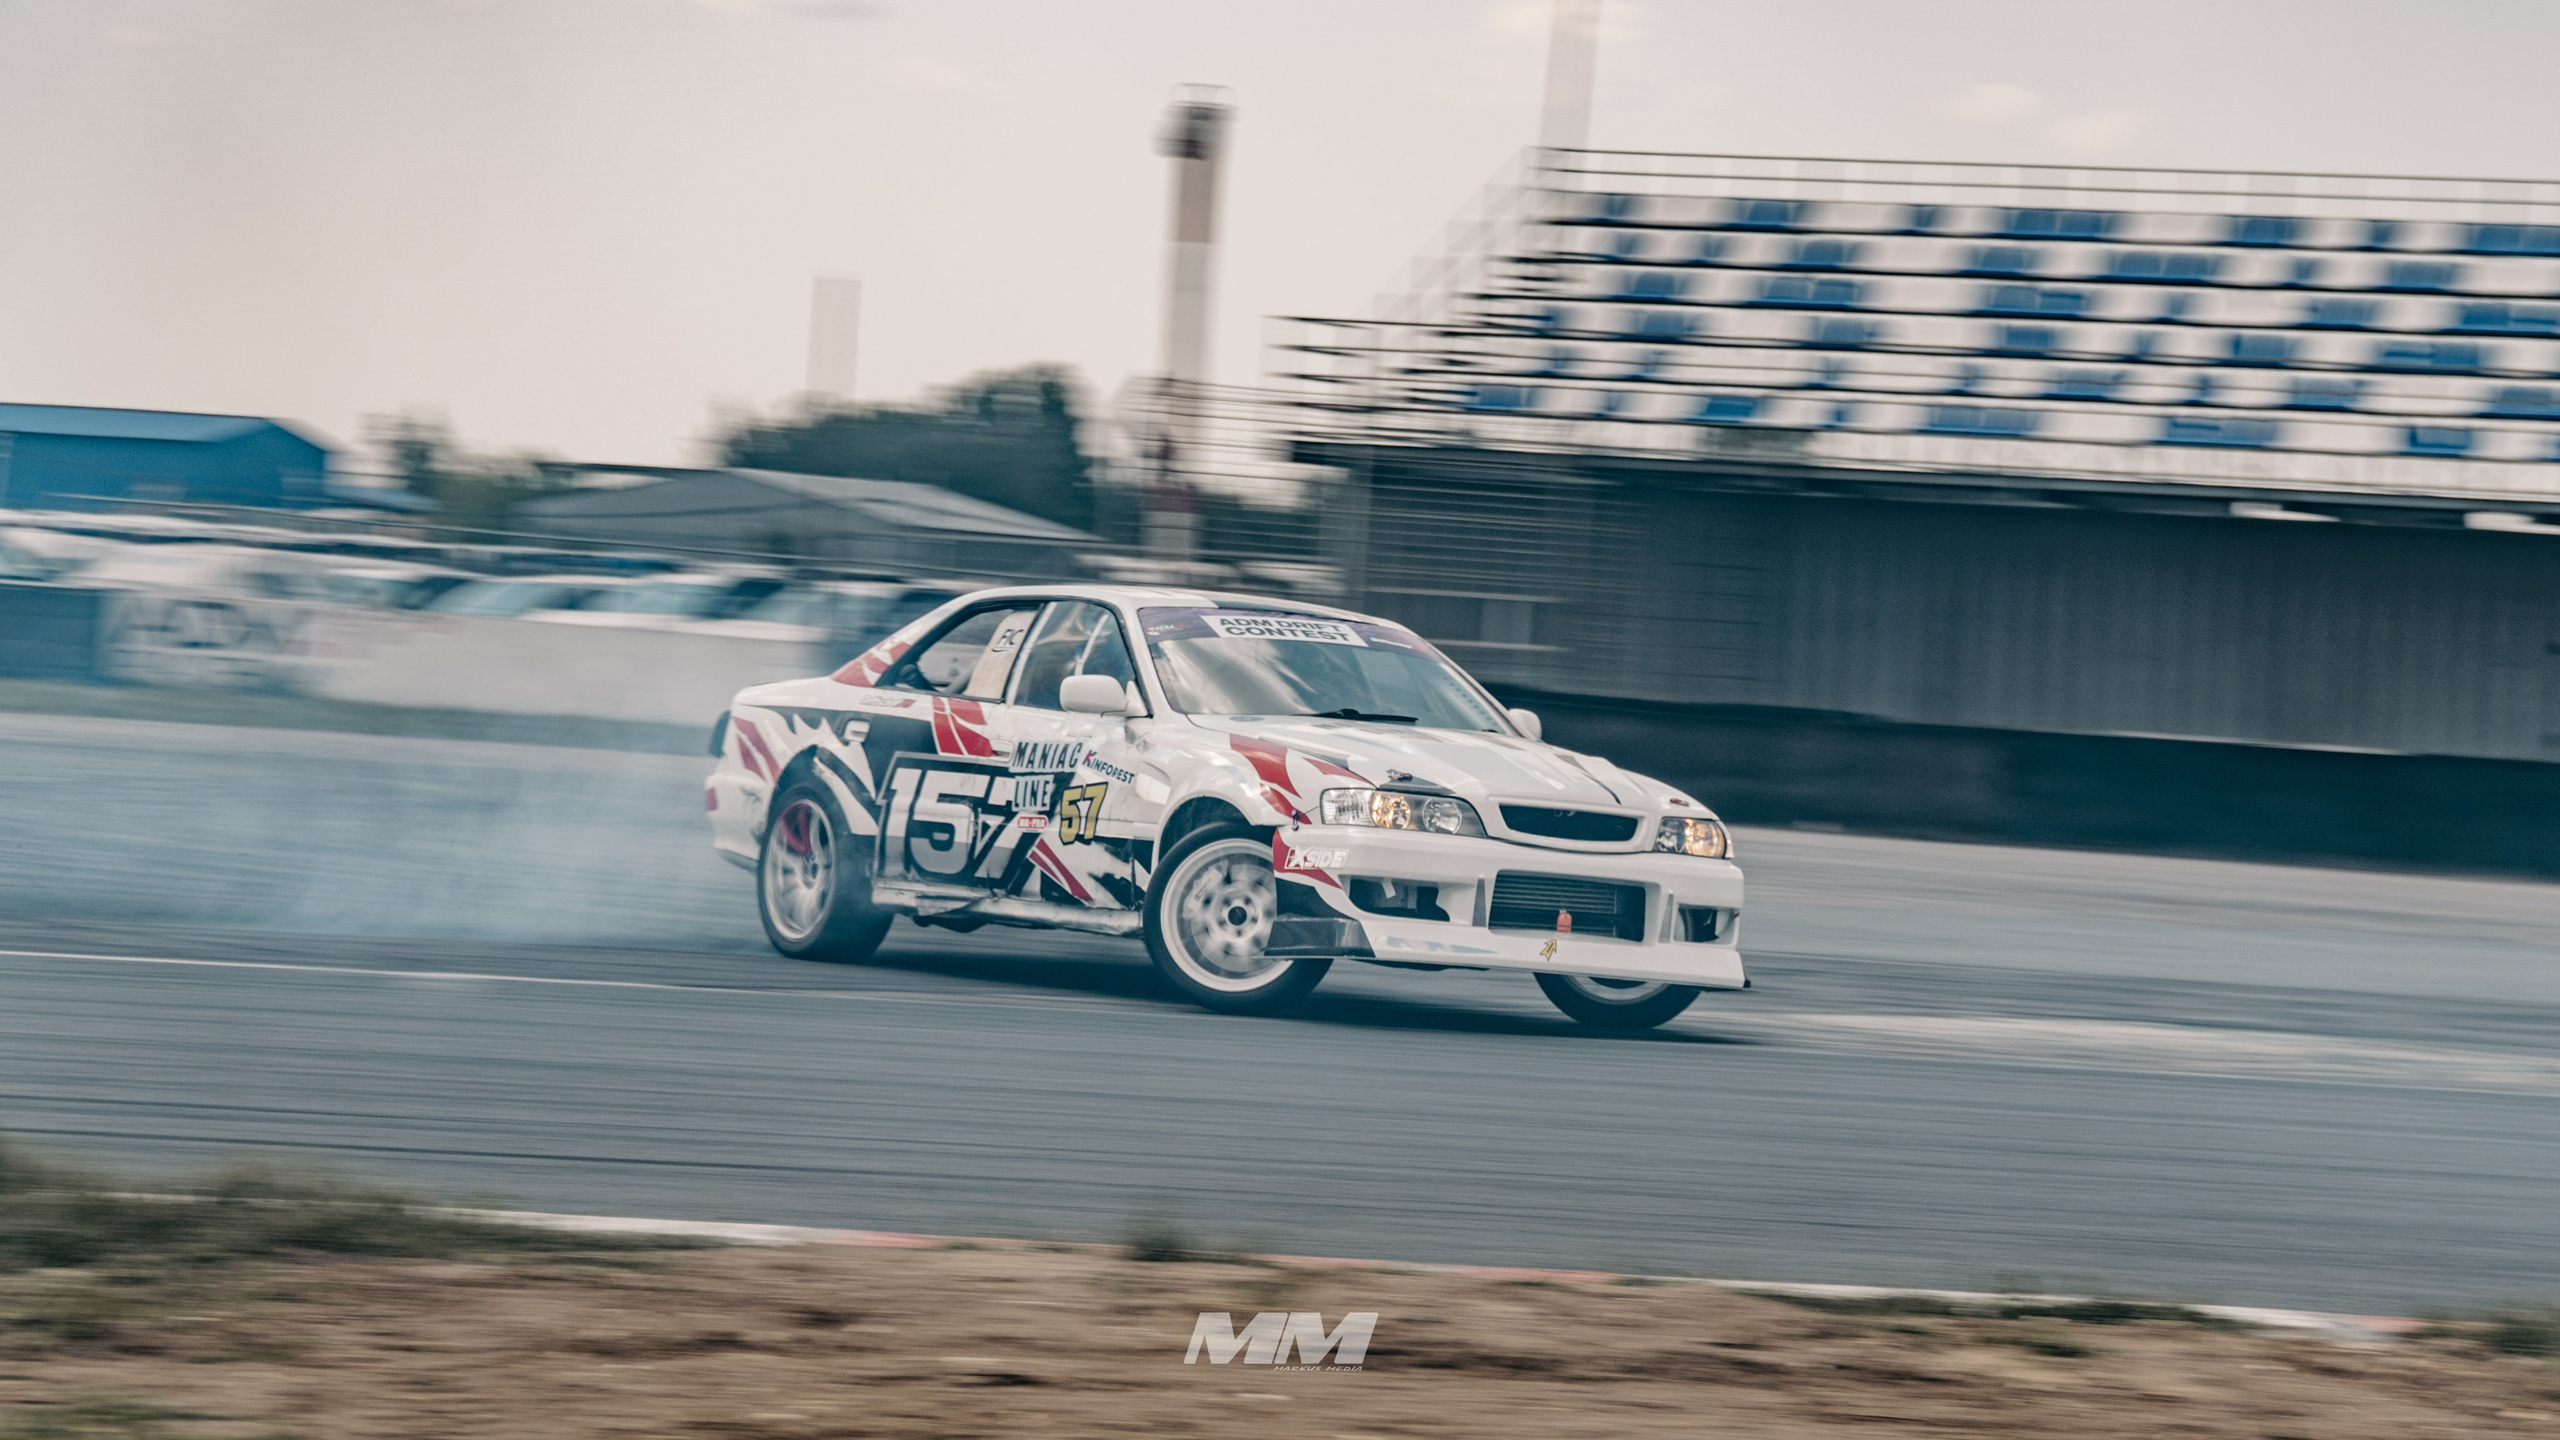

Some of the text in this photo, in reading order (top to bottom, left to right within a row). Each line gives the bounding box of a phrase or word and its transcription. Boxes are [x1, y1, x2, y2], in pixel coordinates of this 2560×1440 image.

[1220, 618, 1342, 632] ADM DRIFT
[1224, 626, 1349, 641] CONTEST
[1012, 741, 1083, 769] MANIAC
[1082, 750, 1135, 784] KINFOREST
[1014, 780, 1053, 807] LINE
[885, 767, 1024, 880] 157
[1059, 781, 1108, 846] 57
